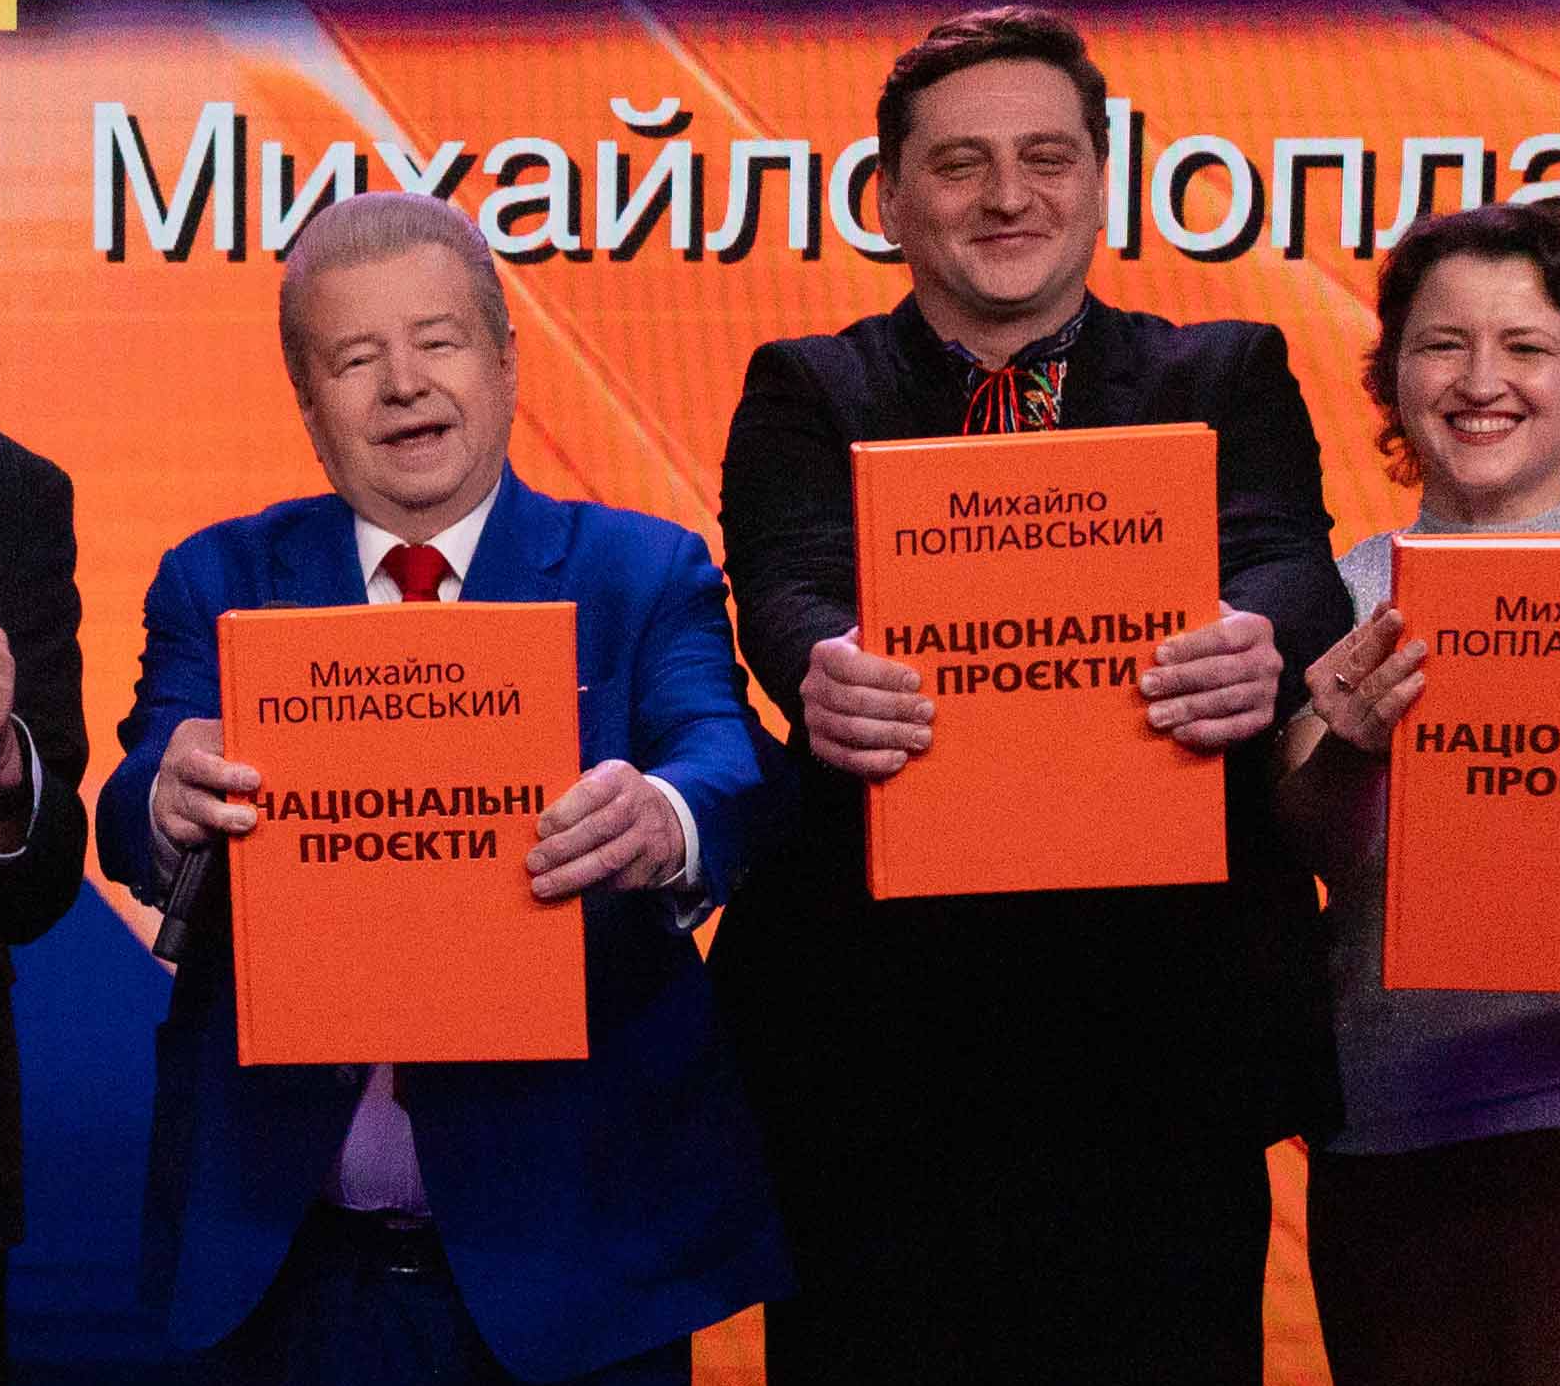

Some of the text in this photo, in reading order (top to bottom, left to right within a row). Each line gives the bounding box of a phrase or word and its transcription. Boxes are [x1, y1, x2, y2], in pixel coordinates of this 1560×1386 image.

[950, 488, 1107, 519] Михайло
[894, 510, 1163, 556] ПОПЛАВСЬКИЙ
[310, 658, 465, 688] Михайло
[936, 657, 1137, 696] ПРОЄКТИ
[258, 682, 521, 724] ПОПЛАВСЬКИЙ
[252, 785, 544, 824] НАЦІОНАЛЬНІ
[300, 830, 497, 863] ПРОЄКТИ
